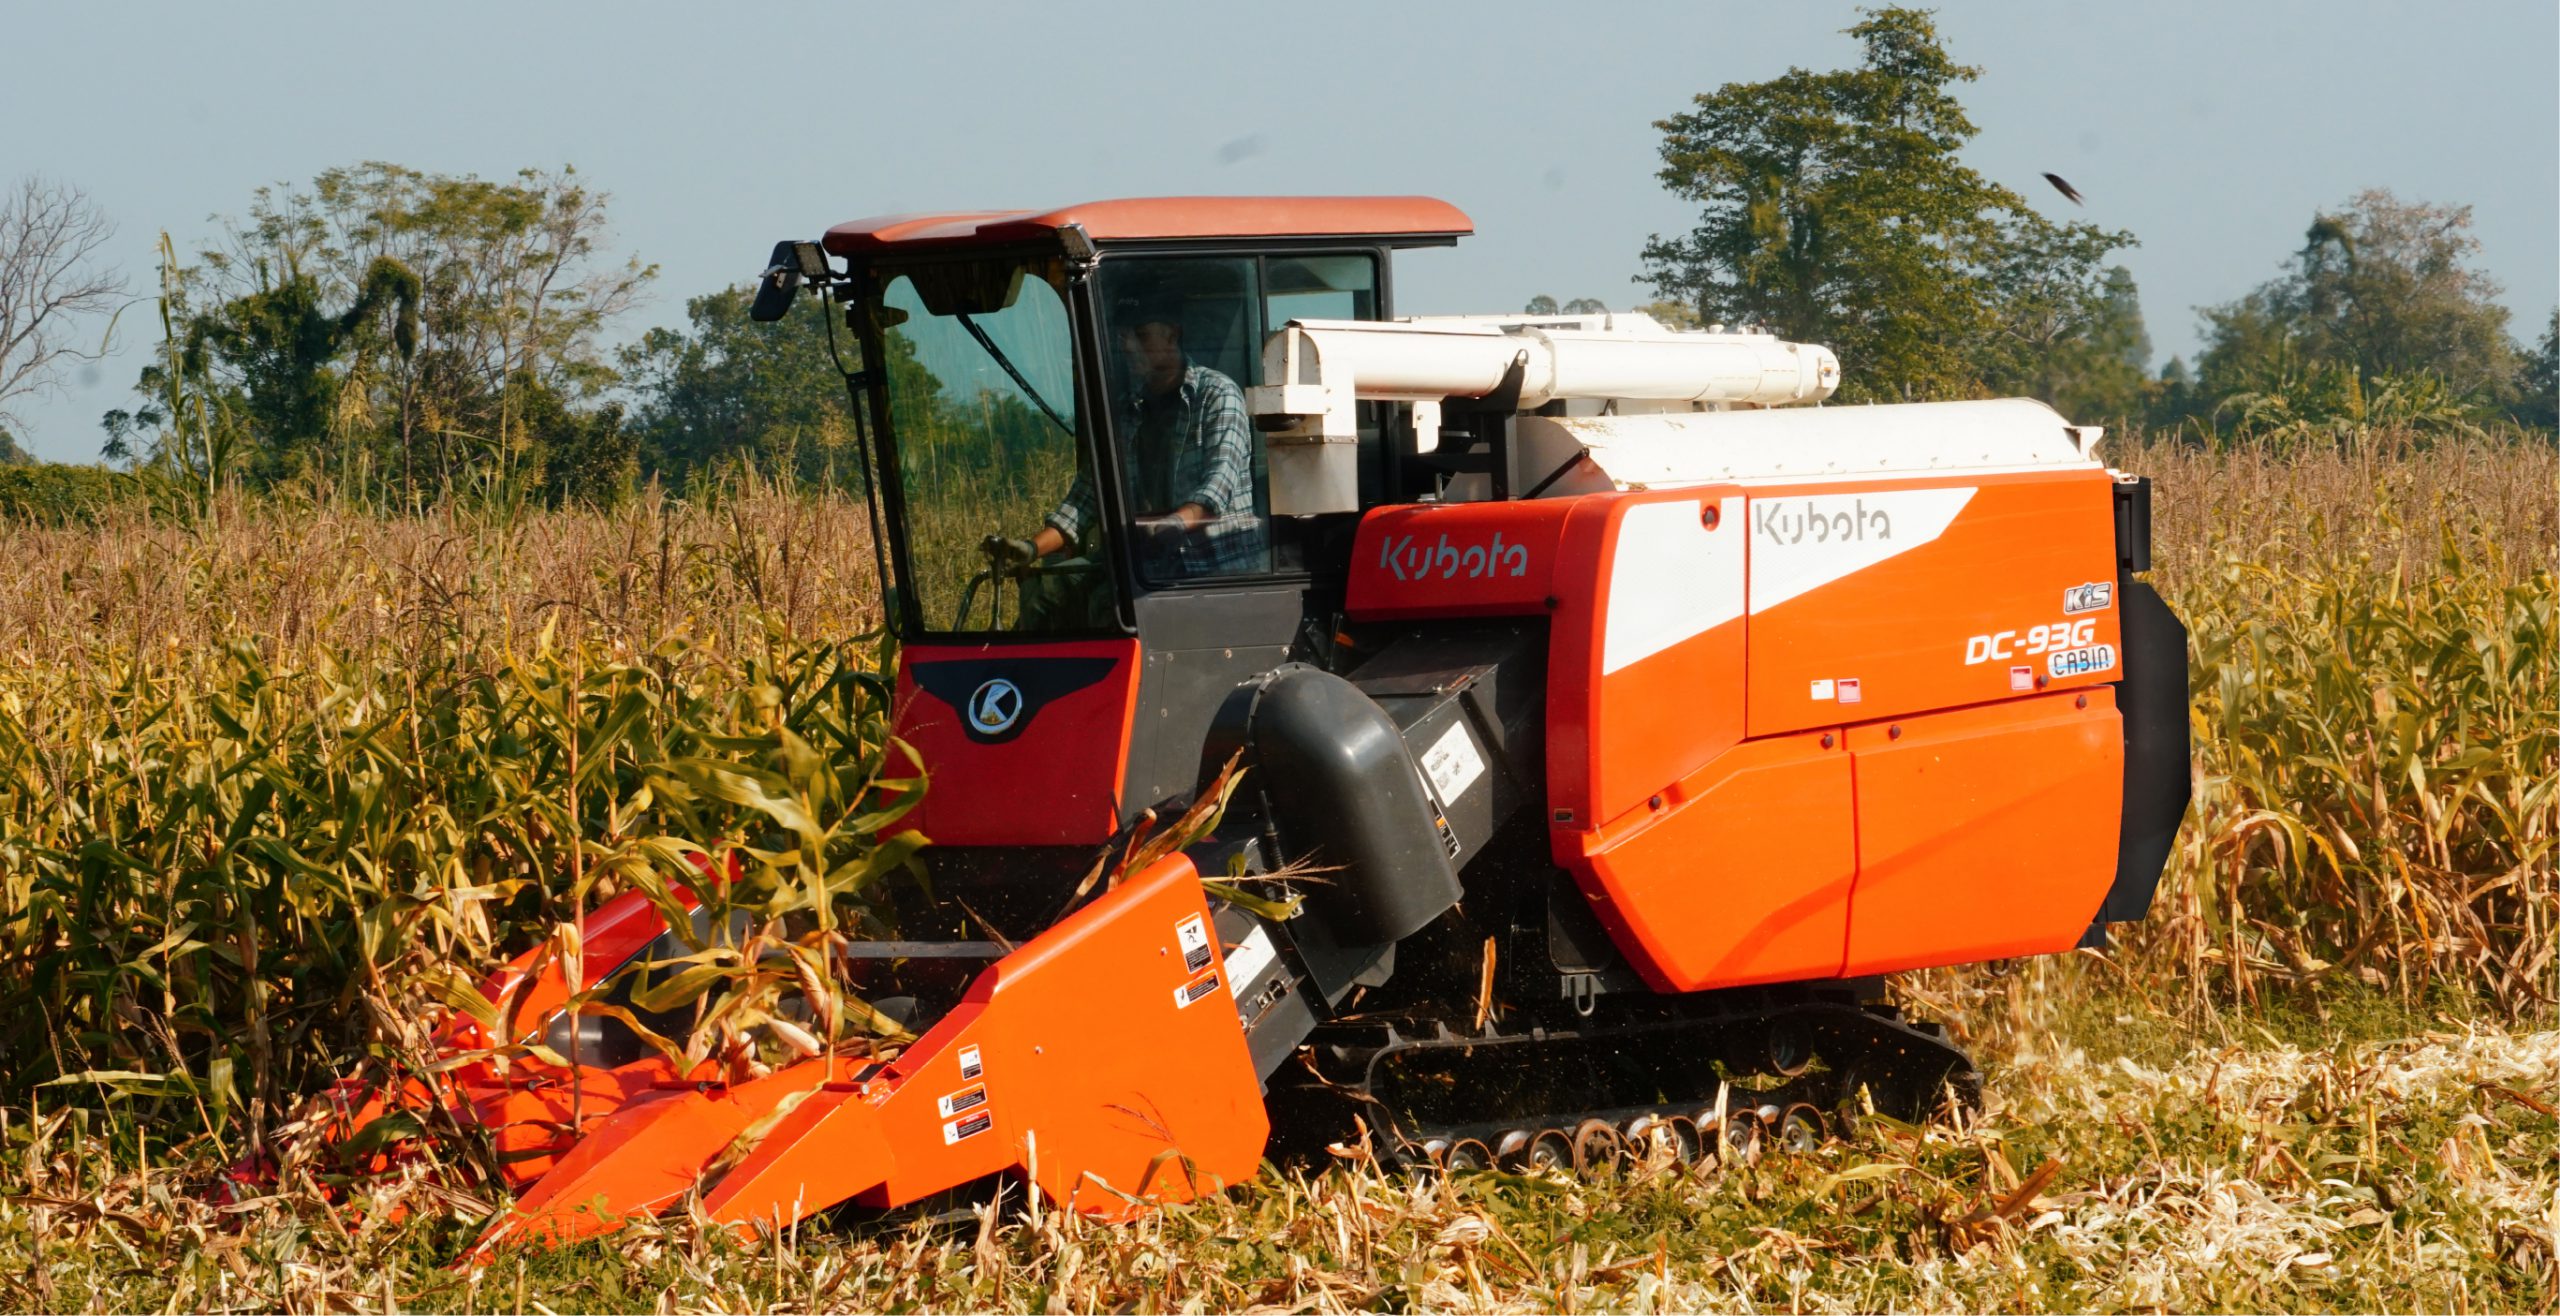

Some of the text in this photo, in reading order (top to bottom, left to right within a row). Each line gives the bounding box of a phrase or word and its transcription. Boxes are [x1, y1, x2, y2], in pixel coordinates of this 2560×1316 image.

[1756, 499, 1891, 545] Kubota
[1380, 532, 1528, 581] Kubota
[1965, 618, 2096, 665] DC-93G
[2053, 647, 2110, 676] CABIN
